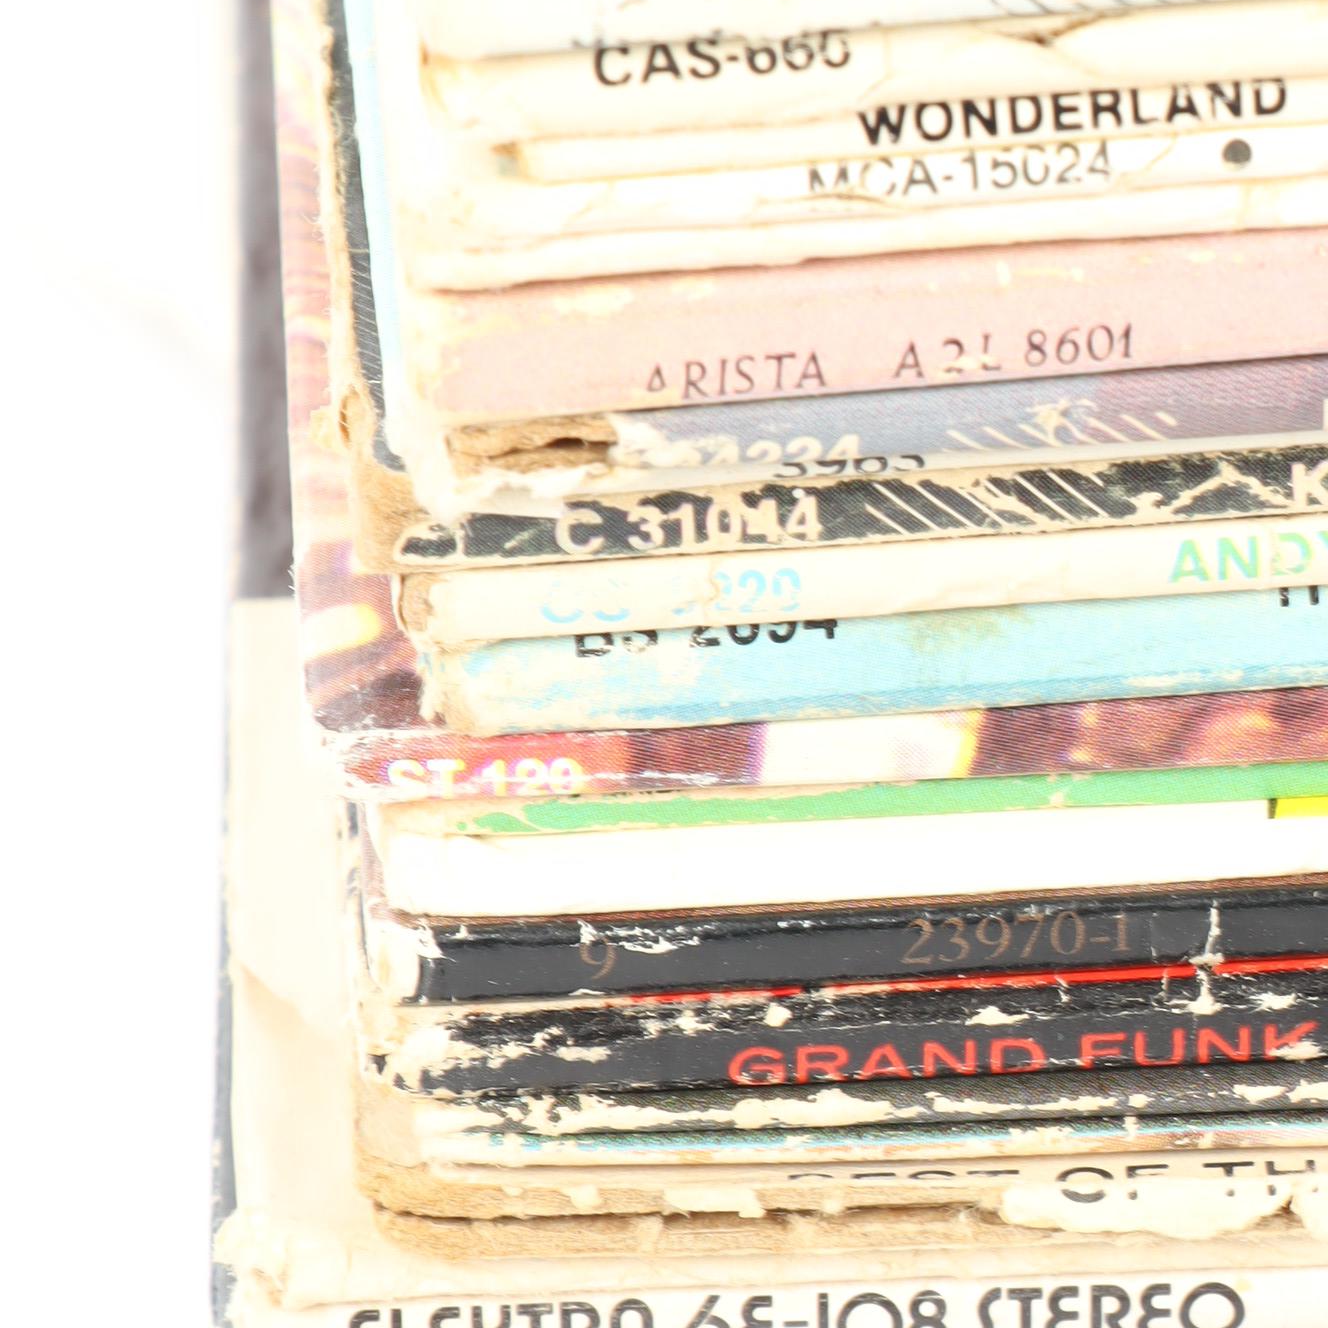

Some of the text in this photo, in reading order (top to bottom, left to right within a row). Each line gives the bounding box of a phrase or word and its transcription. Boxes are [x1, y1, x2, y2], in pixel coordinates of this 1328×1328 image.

[858, 76, 1288, 148] WONDERLAND
[806, 139, 1112, 201] MCA-15024
[645, 350, 828, 401] ARISTA
[1024, 323, 1134, 369] 8601
[899, 910, 1135, 966] 23970-1
[727, 1035, 1047, 1087] GRAND
[1078, 1020, 1320, 1072] FUNK
